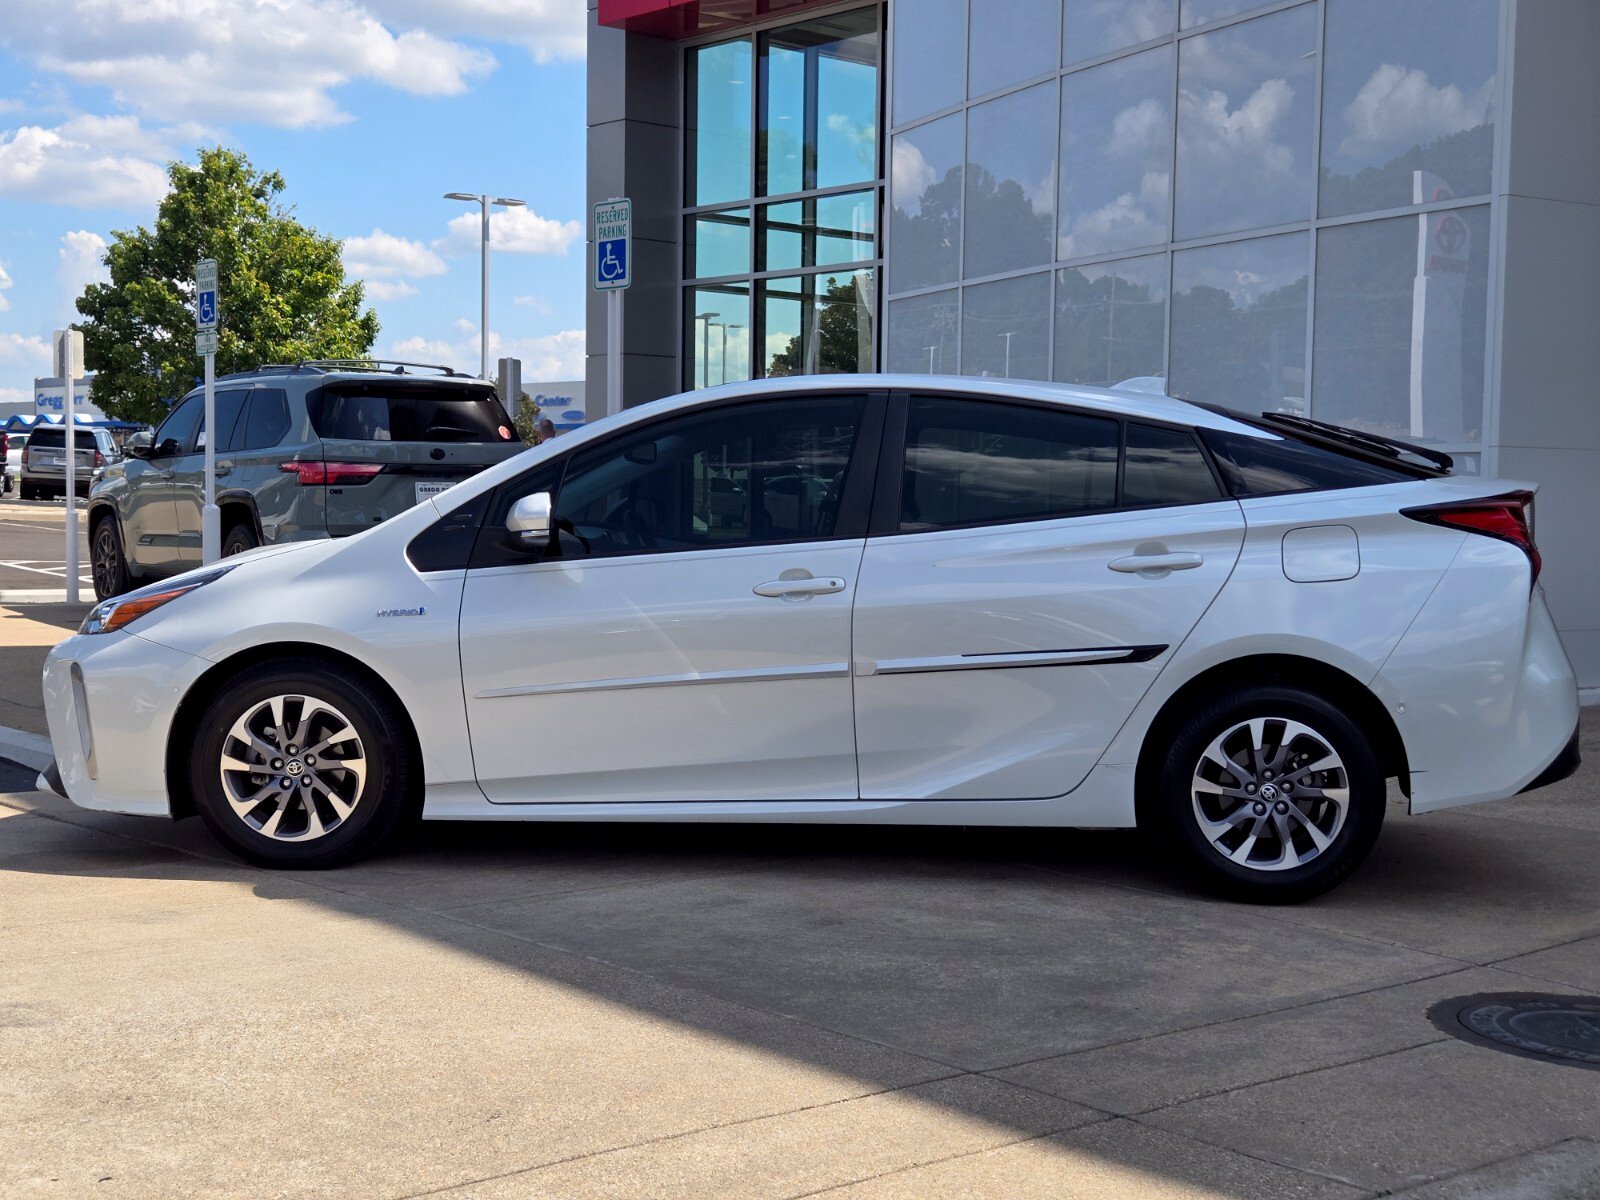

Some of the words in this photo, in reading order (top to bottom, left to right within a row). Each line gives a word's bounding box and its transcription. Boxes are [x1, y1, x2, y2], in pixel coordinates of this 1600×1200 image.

[596, 208, 628, 224] RESERVED
[598, 224, 627, 239] PARKING
[37, 393, 63, 410] Gregg
[535, 394, 573, 407] Center
